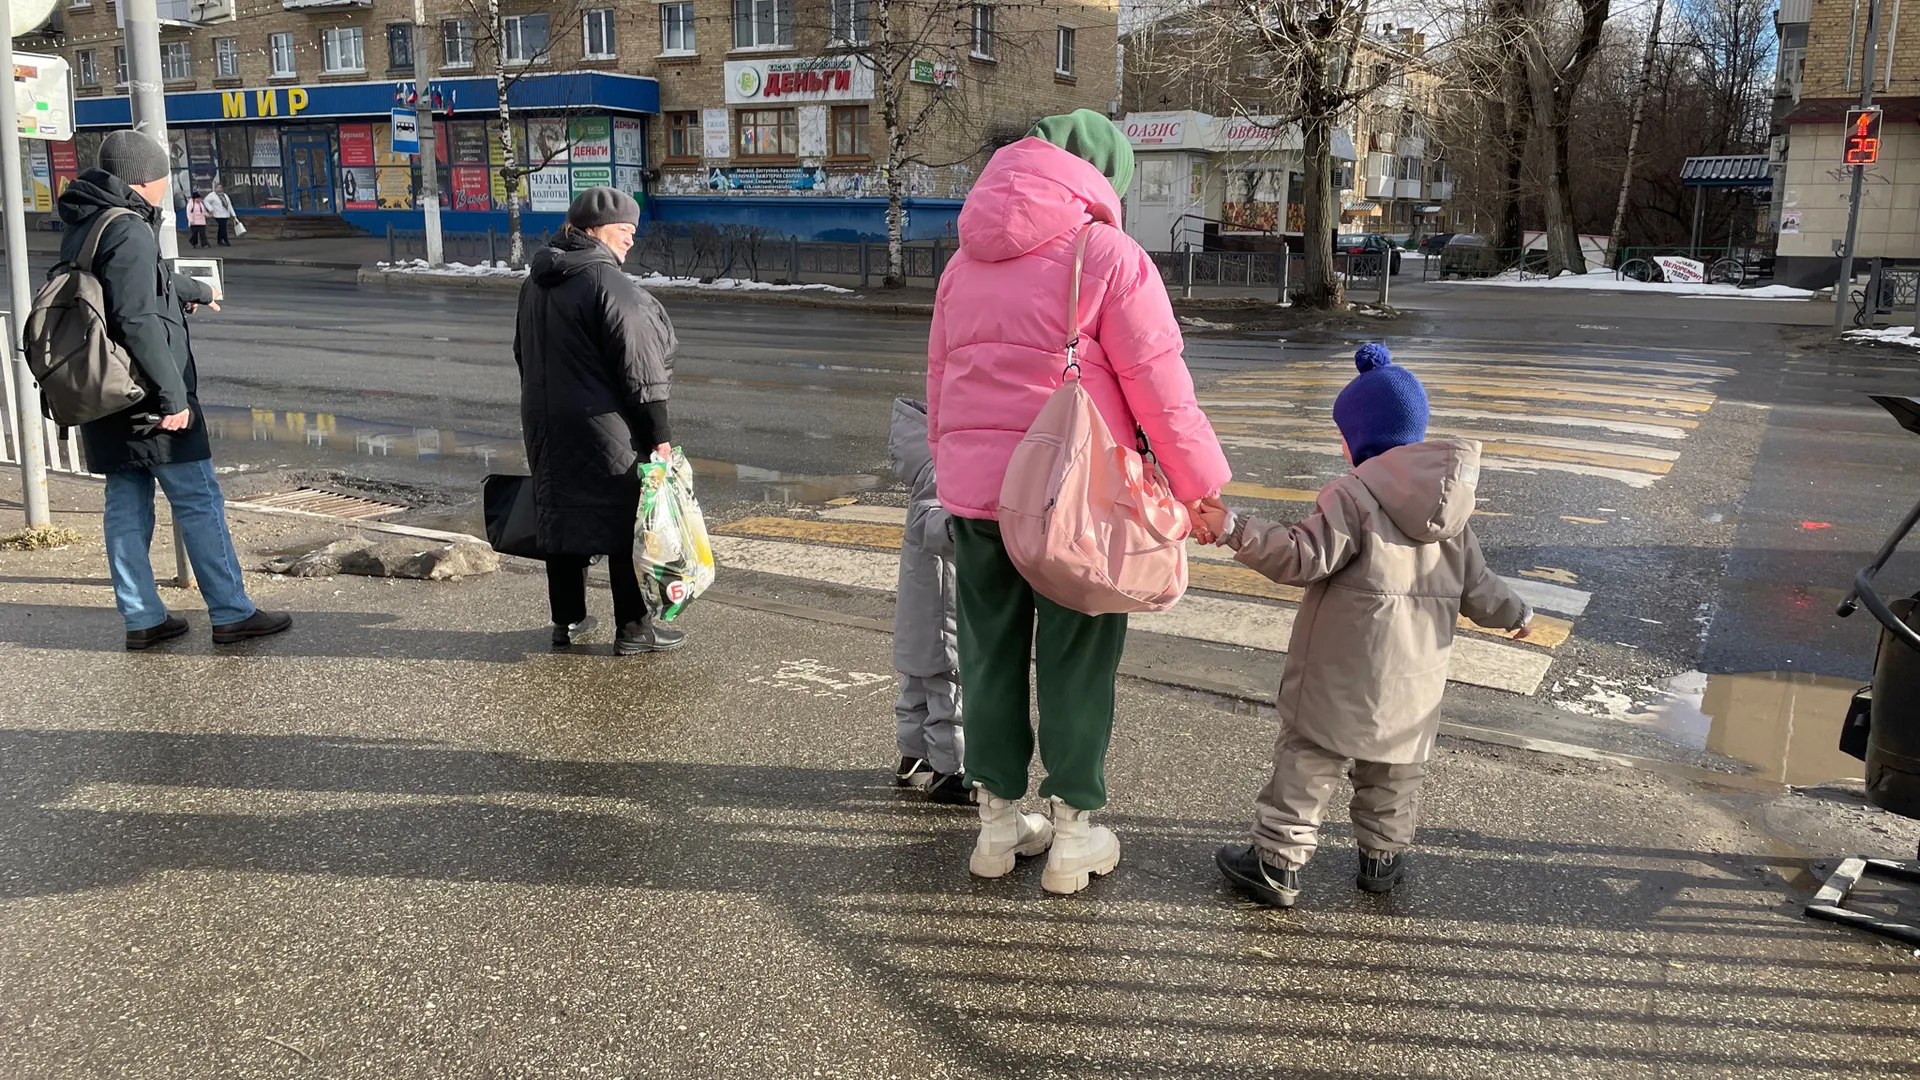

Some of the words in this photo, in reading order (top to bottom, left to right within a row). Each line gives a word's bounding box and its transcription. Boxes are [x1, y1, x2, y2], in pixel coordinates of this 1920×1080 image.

[768, 63, 791, 72] КАССА
[763, 70, 851, 97] ДЕНЬГИ
[222, 88, 308, 118] МИР
[614, 120, 639, 130] ДЕНЬГИ
[1127, 122, 1181, 137] ОАЗИС
[573, 146, 608, 157] ДЕНЬГИ
[1847, 138, 1877, 163] 29
[531, 174, 567, 185] ЧУЛКИ
[532, 190, 568, 199] КОЛГОТКИ
[1663, 260, 1703, 281] ВЕЛОРЕМОНТ
[671, 584, 684, 600] Б
